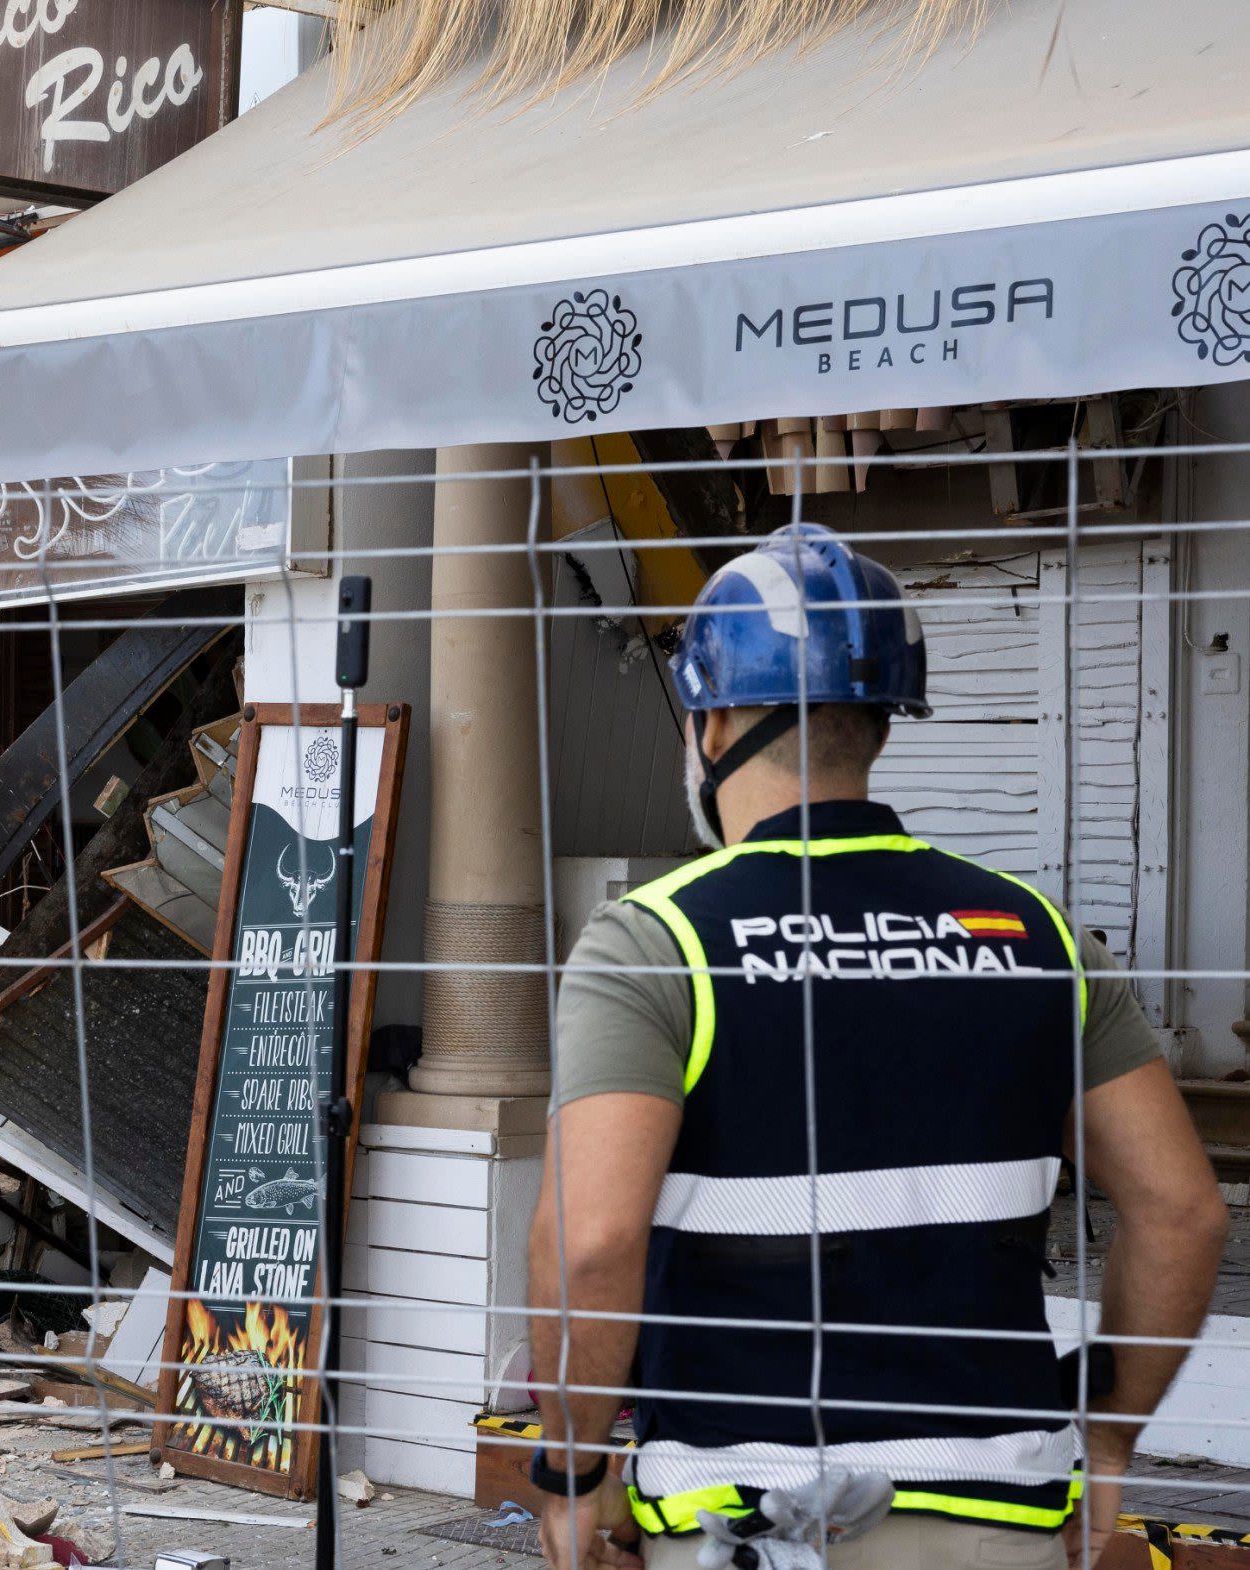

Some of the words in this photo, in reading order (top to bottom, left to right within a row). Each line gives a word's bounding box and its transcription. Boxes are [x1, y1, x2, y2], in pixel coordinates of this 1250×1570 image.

[26, 43, 204, 173] Rico
[735, 278, 1054, 352] MEDUSA
[817, 339, 959, 374] BEACH
[280, 786, 342, 800] MEDUS
[284, 800, 317, 808] BECH
[321, 801, 340, 809] CLU
[238, 929, 283, 983] BBQ
[292, 928, 338, 977] GRIL
[740, 944, 1043, 985] NACIONAL
[252, 989, 329, 1024] FILETSTEAK
[241, 1078, 285, 1111] SPARE
[286, 1078, 317, 1111] RIBS
[234, 1122, 276, 1155] MIXED
[277, 1122, 309, 1155] GRILL
[214, 1174, 246, 1202] AND
[225, 1226, 291, 1261] GRILLED
[293, 1228, 317, 1262] ON
[198, 1259, 244, 1300] LAVA
[251, 1262, 311, 1303] STONE
